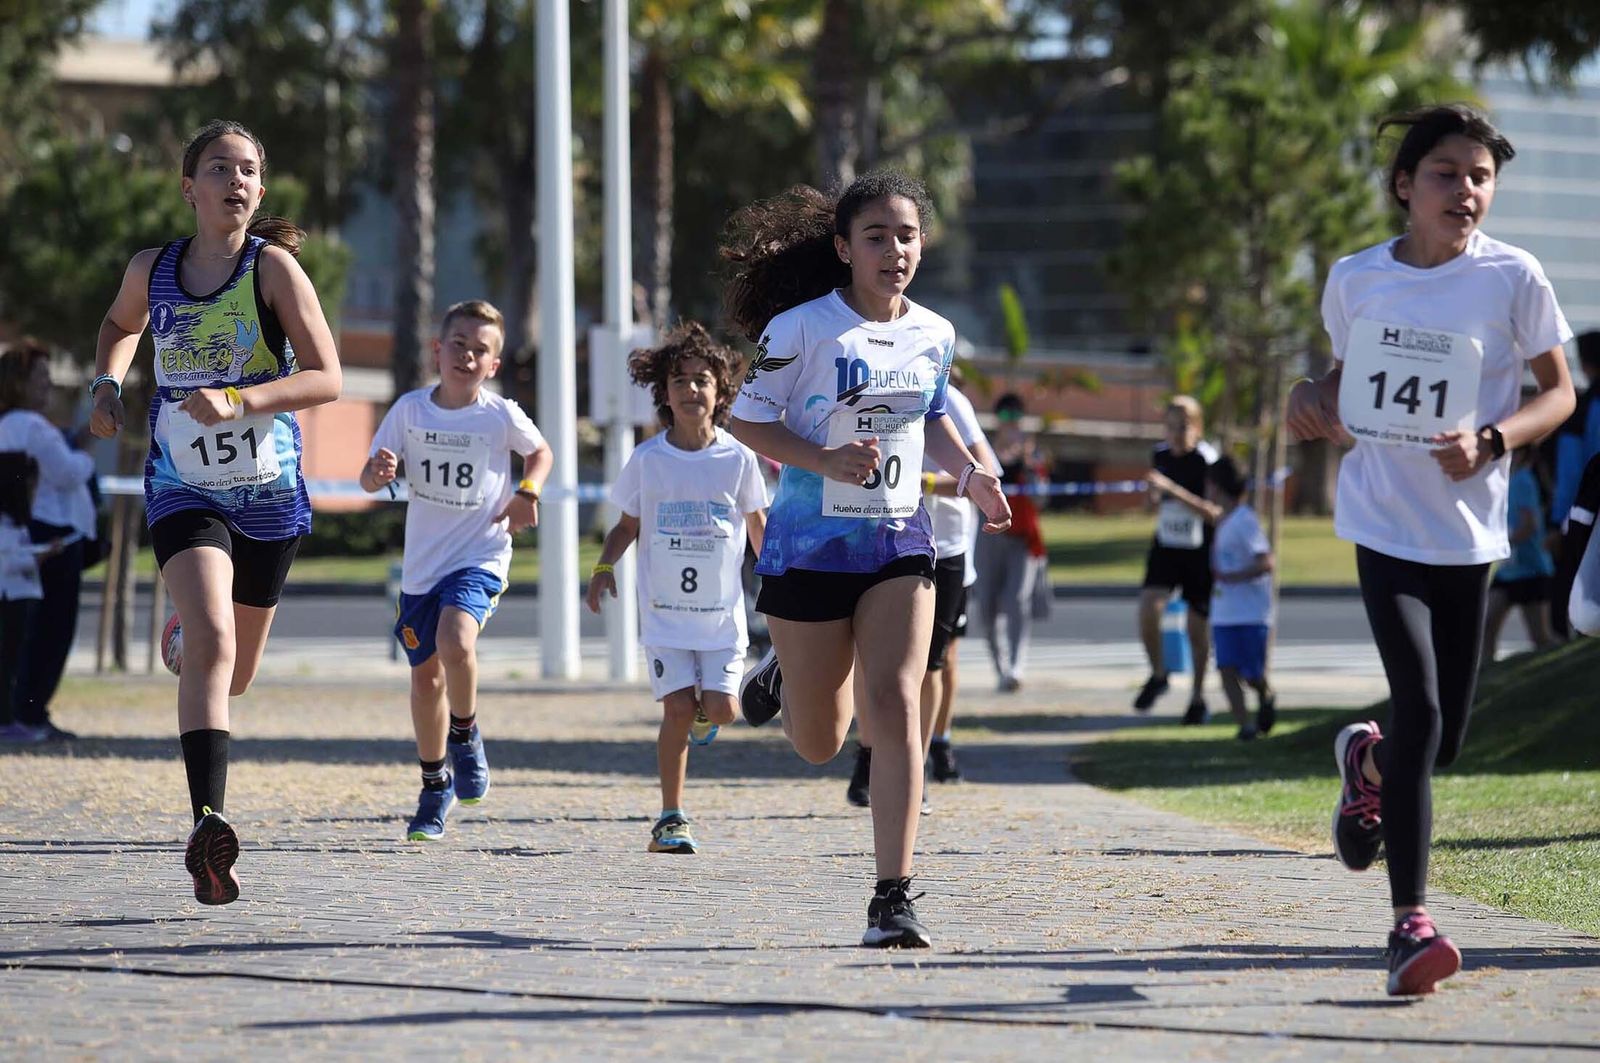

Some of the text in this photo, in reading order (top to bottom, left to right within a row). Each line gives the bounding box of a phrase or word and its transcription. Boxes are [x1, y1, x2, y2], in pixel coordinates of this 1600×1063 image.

[1383, 328, 1400, 342] H
[835, 357, 921, 401] 10 HUELVA
[1368, 371, 1449, 419] 141
[858, 416, 872, 429] H
[191, 427, 258, 466] 151
[426, 431, 437, 441] H
[421, 459, 473, 489] 118
[833, 504, 862, 514] Huelva
[883, 506, 894, 514] tus
[894, 505, 915, 514] sentidos
[670, 538, 681, 547] H
[680, 566, 698, 594] 8
